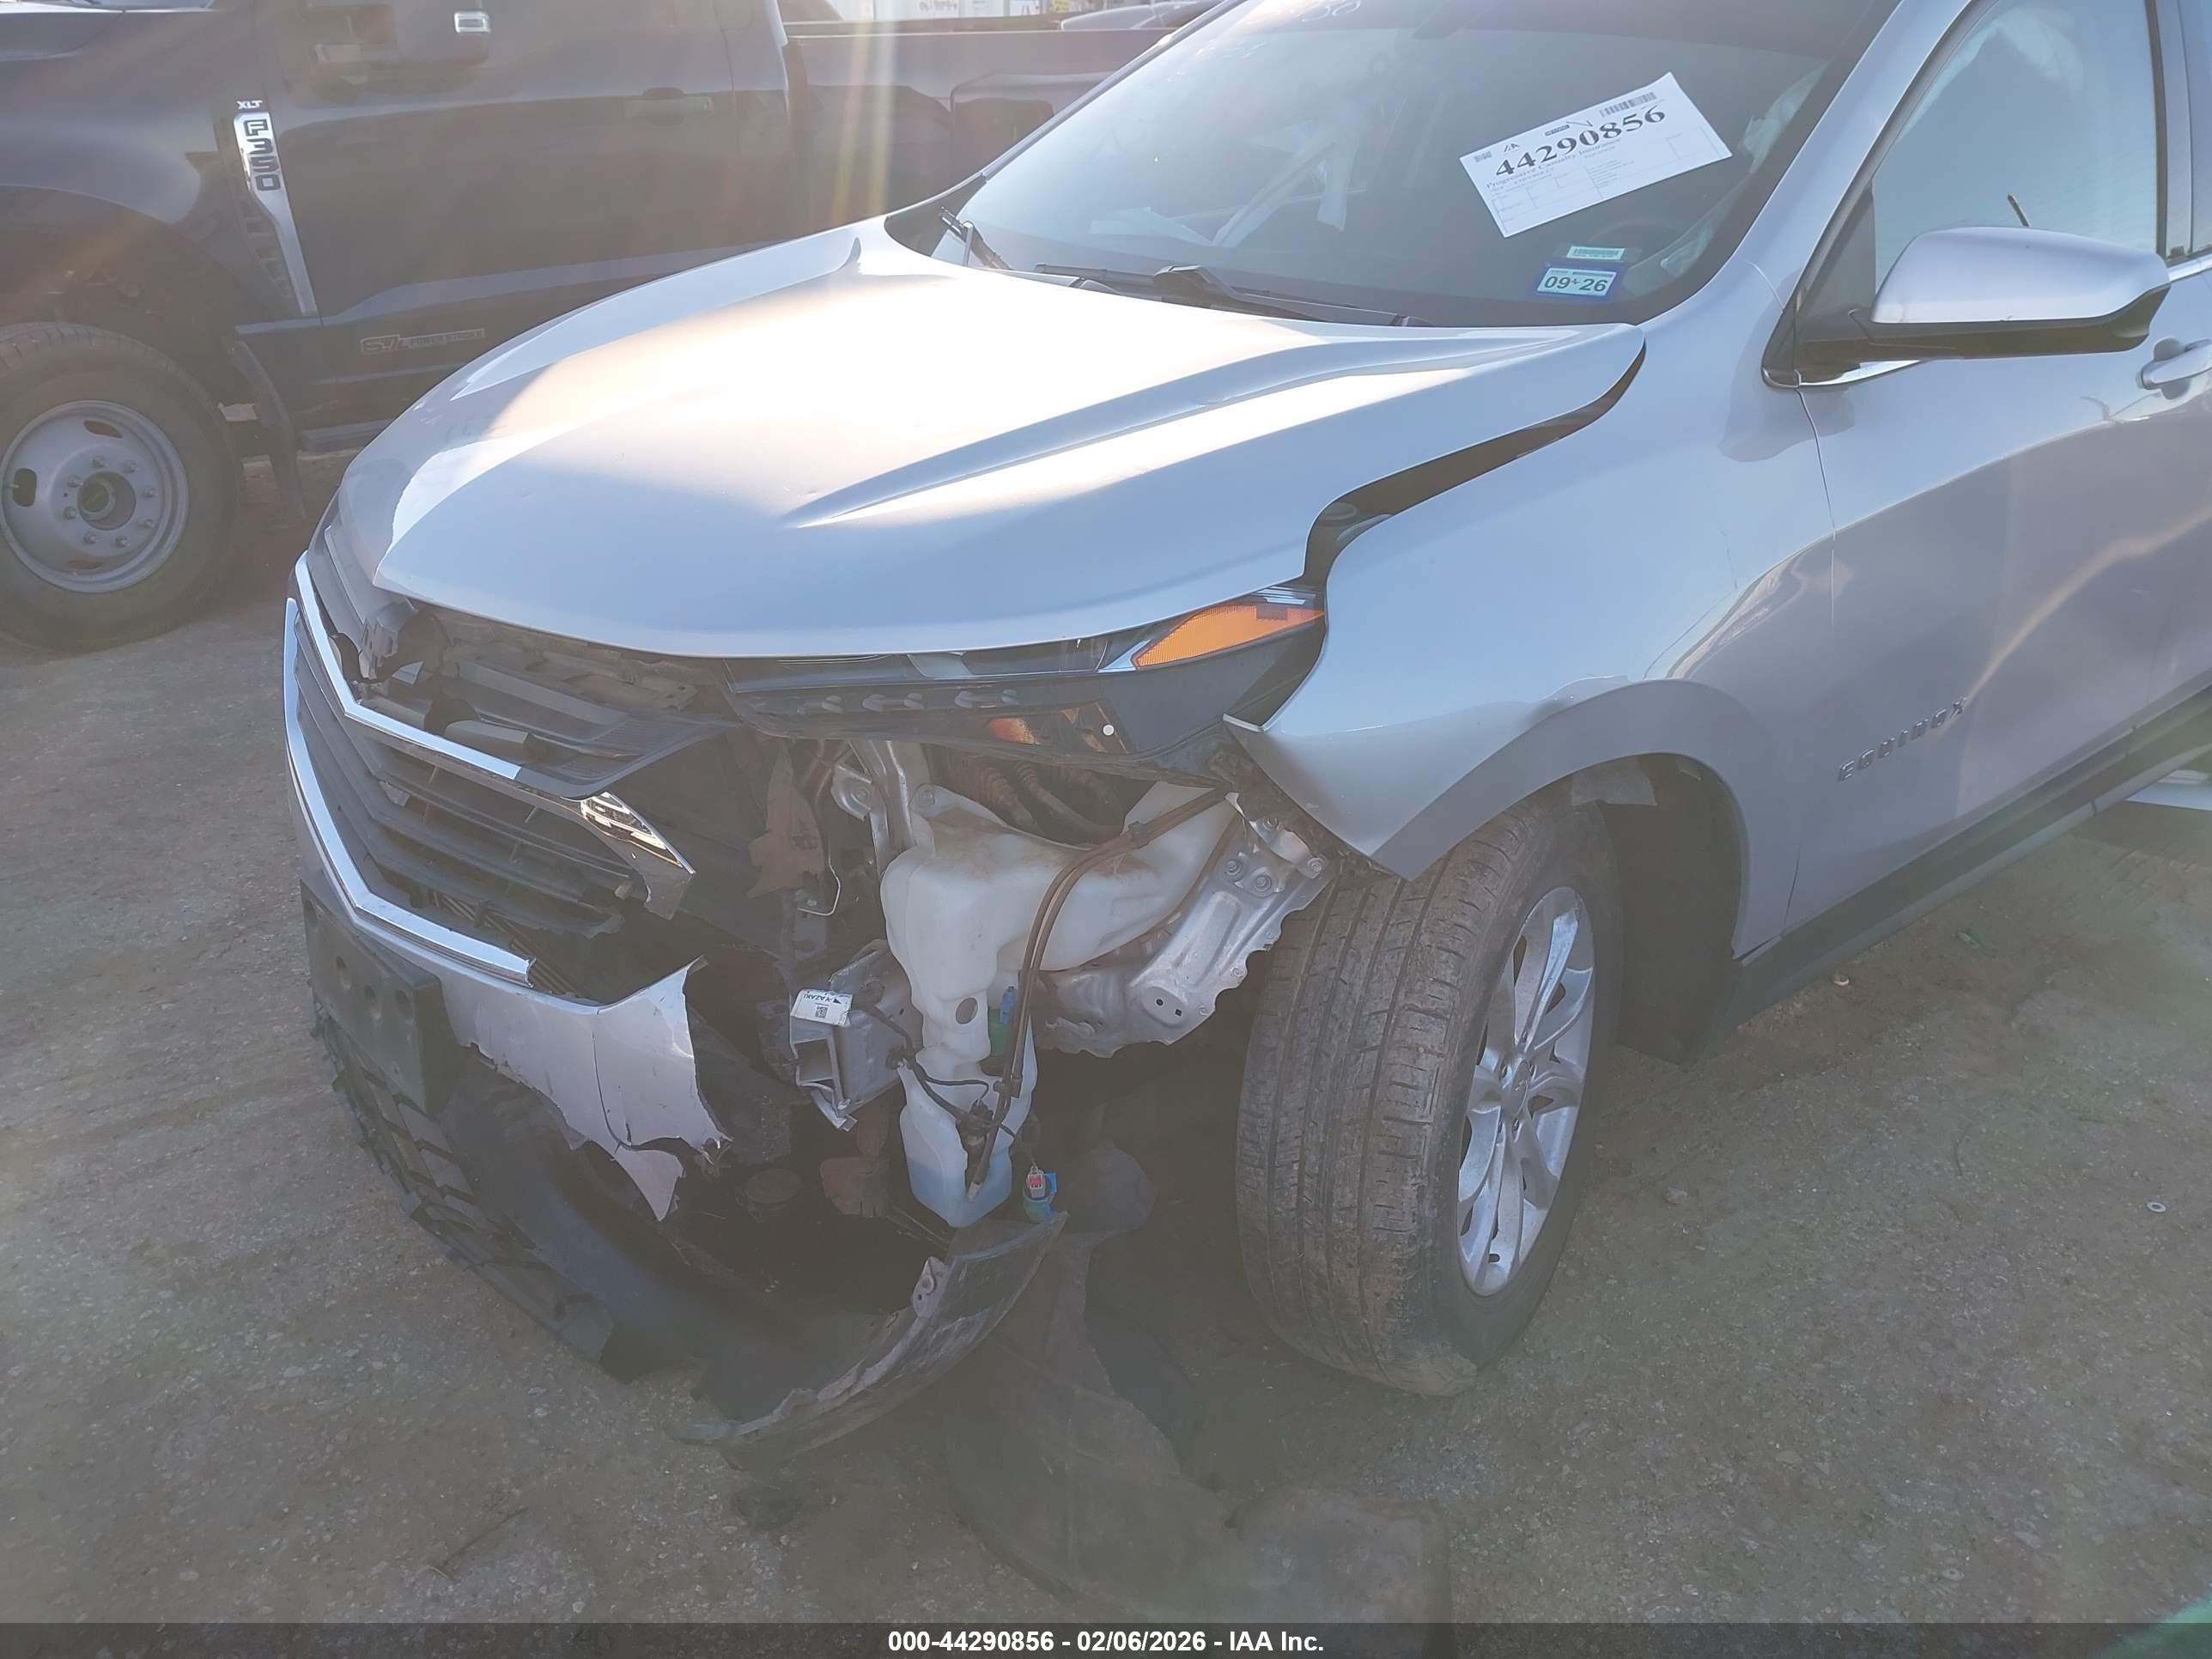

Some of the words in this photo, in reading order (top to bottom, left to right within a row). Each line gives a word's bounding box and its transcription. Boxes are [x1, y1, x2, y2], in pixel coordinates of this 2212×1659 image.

[236, 100, 264, 110] XLT
[243, 118, 282, 191] F350
[1495, 105, 1666, 176] 44290856
[1544, 276, 1571, 289] 09
[1578, 278, 1608, 292] 26
